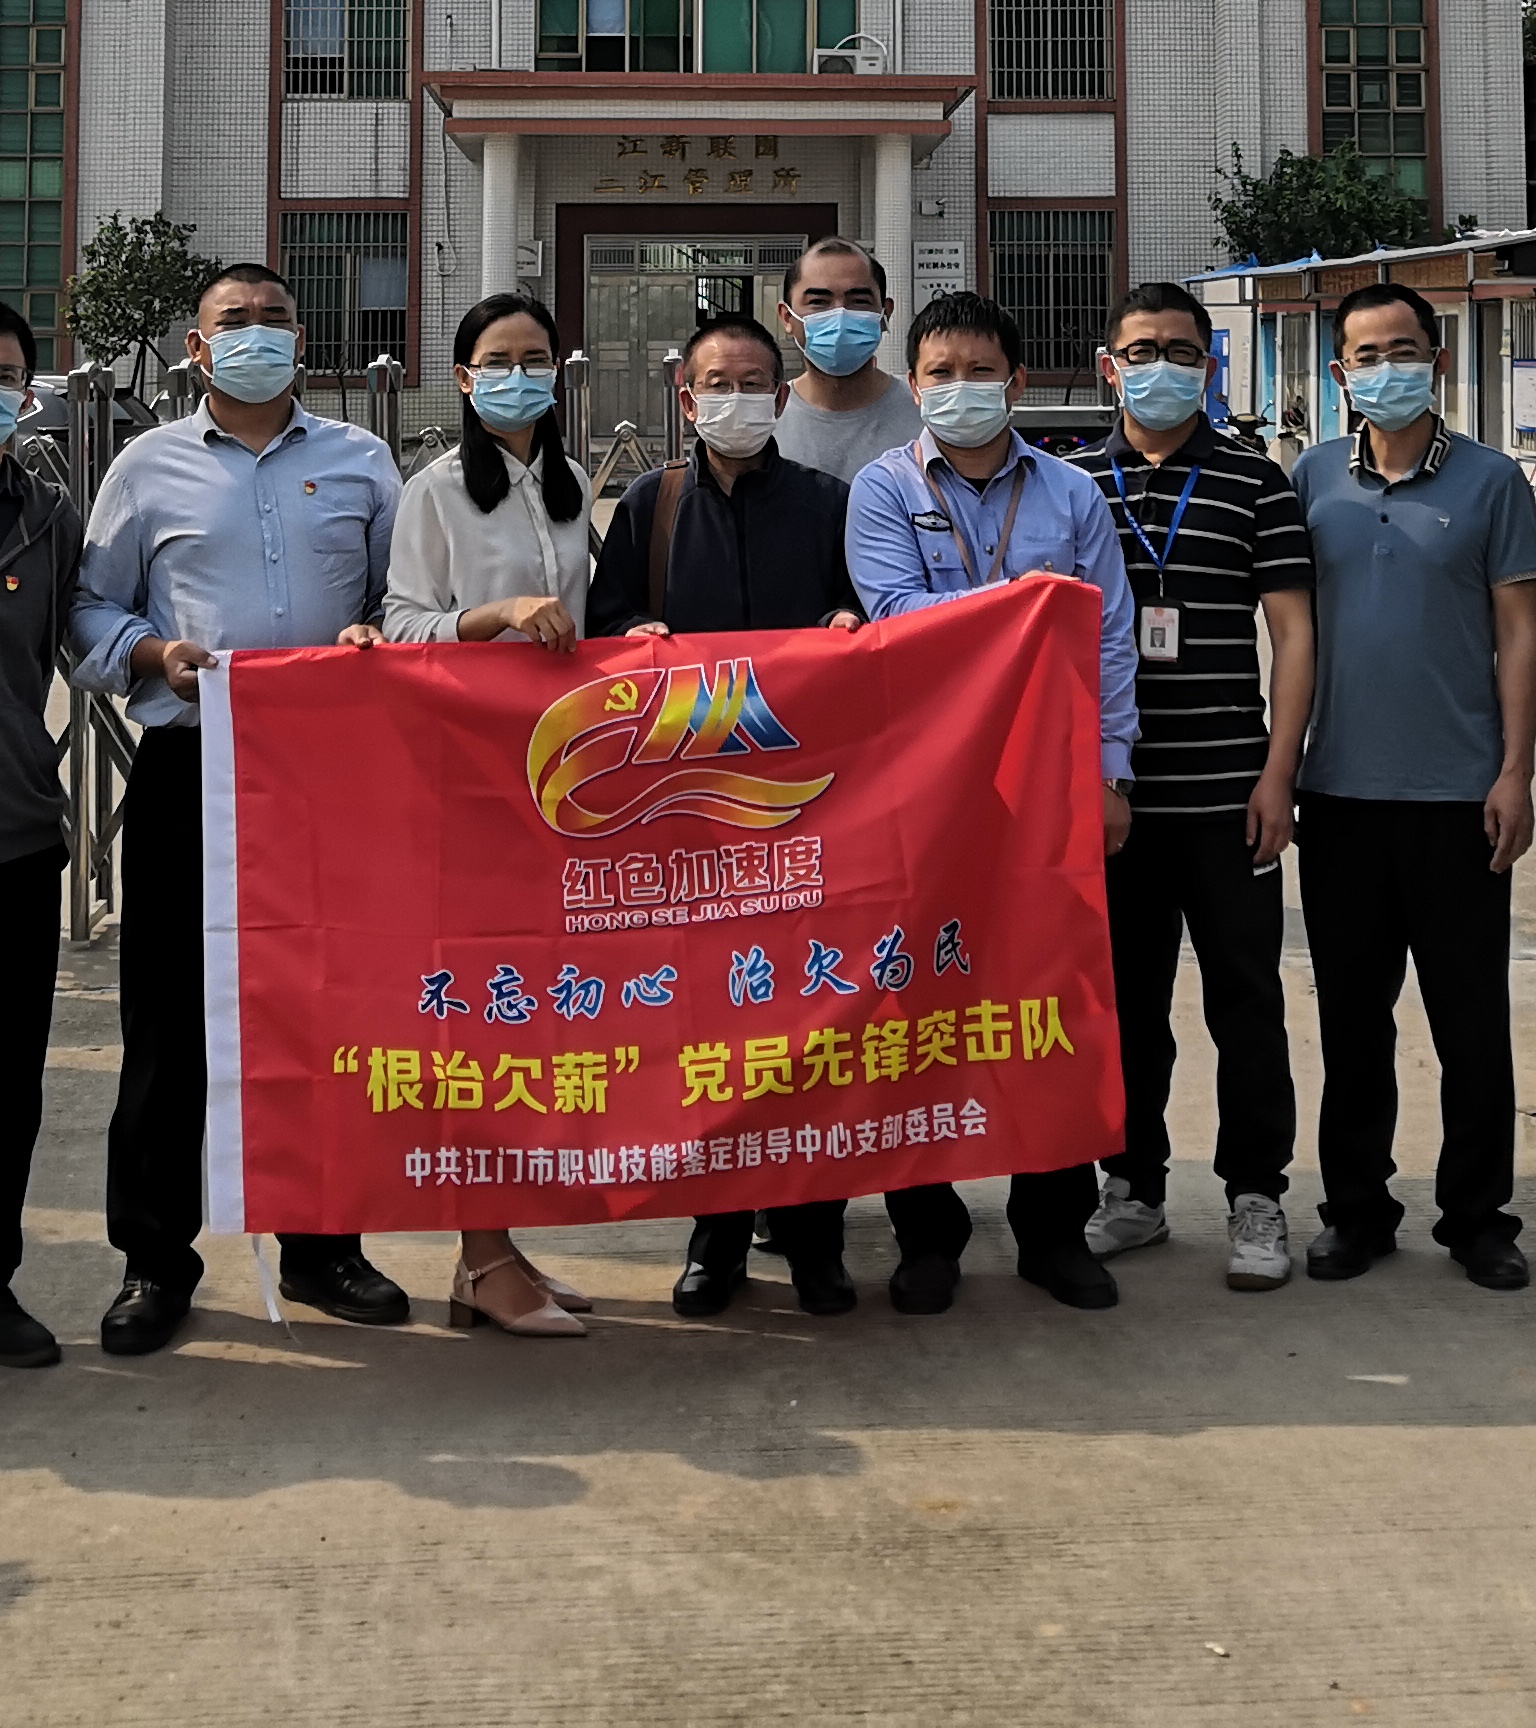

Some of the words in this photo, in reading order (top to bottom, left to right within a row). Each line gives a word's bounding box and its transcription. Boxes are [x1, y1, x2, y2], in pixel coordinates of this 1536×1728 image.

[562, 836, 823, 909] 红色加速度
[565, 911, 649, 934] HONG
[651, 906, 689, 927] SE
[691, 901, 739, 922] JIA
[739, 894, 780, 915] SU
[781, 889, 824, 911] DU
[417, 962, 678, 1024] 不忘初心
[728, 917, 972, 1007] 治欠为民
[332, 1045, 641, 1116] “根治欠薪”
[677, 996, 1076, 1108] 党员先锋突击队
[404, 1097, 989, 1188] 中共江门市职业技能鉴定指导中心支部委员会
